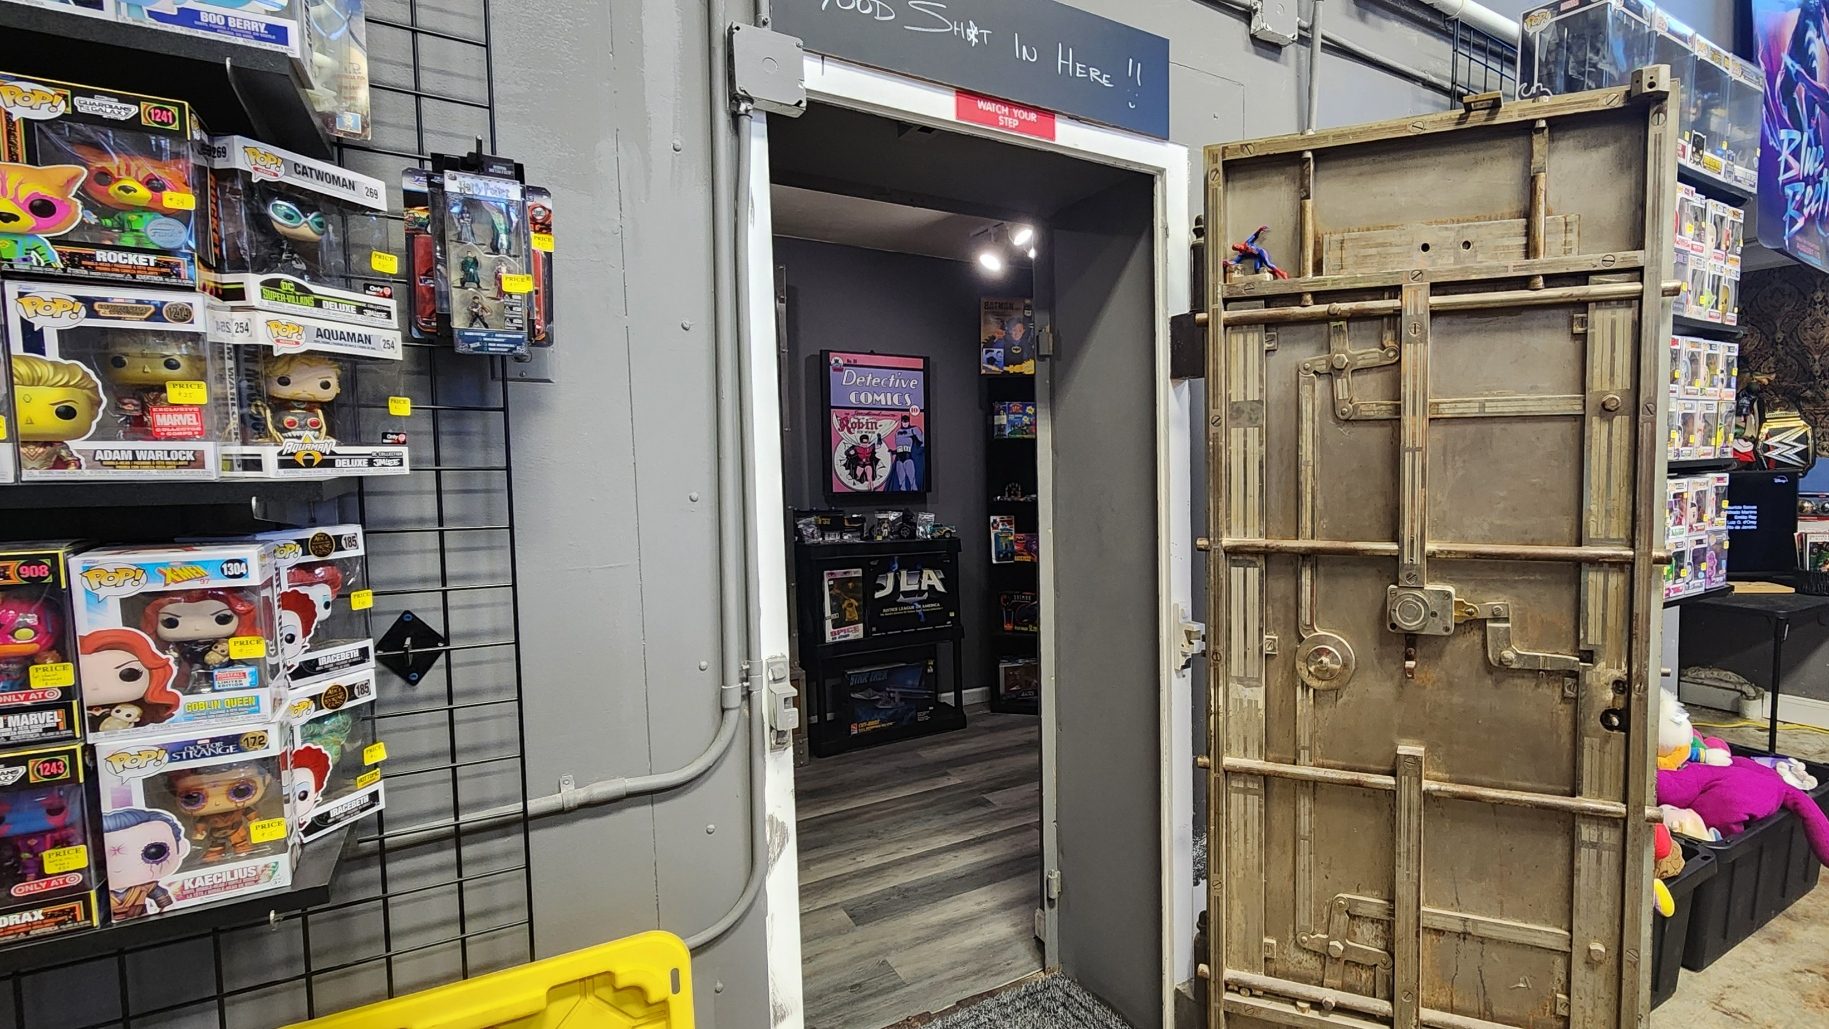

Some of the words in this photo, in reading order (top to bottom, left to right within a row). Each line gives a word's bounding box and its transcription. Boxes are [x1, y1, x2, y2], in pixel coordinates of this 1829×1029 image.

[200, 11, 225, 26] BOO
[822, 0, 896, 21] OOD
[1014, 32, 1038, 63] IN
[1057, 42, 1115, 88] HERE
[0, 84, 64, 114] POP!
[149, 107, 173, 124] 1241
[977, 99, 1010, 117] WATCH
[1011, 106, 1038, 124] YOUR
[998, 115, 1020, 130] STEP
[242, 145, 285, 173] POP!
[1778, 128, 1826, 187] Blue
[293, 161, 357, 192] CATWOMAN
[364, 185, 380, 200] 269
[95, 250, 157, 266] ROCKET
[280, 280, 295, 293] DC
[262, 288, 315, 308] SUPER-VILLAINS
[322, 299, 357, 314] DELUXE
[15, 296, 85, 320] POP!
[234, 321, 250, 335] 254
[265, 319, 305, 341] POP!
[315, 327, 372, 346] AQUAMAN
[382, 339, 395, 351] 254
[842, 369, 918, 389] Detective
[849, 391, 912, 406] COMICS
[155, 413, 199, 426] MARVEL
[94, 449, 133, 461] ADAM
[135, 450, 195, 461] WARLOCK
[282, 439, 336, 456] AQUAMAN
[335, 458, 369, 469] DELUXE
[343, 535, 358, 548] 185
[19, 564, 50, 578] 908
[221, 562, 247, 576] 1304
[80, 567, 147, 591] POP!
[874, 567, 948, 599] JLA
[233, 639, 263, 647] PRICE
[317, 649, 360, 665] IRACEBETH
[34, 664, 70, 673] PRICE
[29, 691, 44, 700] AT
[355, 682, 370, 697] 185
[184, 700, 221, 713] GOBLIN
[225, 696, 256, 708] QUEEN
[7, 710, 62, 728] MARVEL
[171, 744, 239, 761] STRANGE
[243, 735, 266, 747] 172
[184, 741, 225, 752] DOCTOR
[38, 760, 65, 777] 1243
[104, 749, 168, 775] POP!
[329, 794, 370, 819] IRACEBETH
[254, 821, 284, 831] PRICE
[48, 847, 82, 859] PRICE
[14, 880, 48, 894] ONLY
[50, 878, 65, 887] AT
[183, 866, 257, 890] KAECILIUS
[0, 908, 46, 928] DRAX
